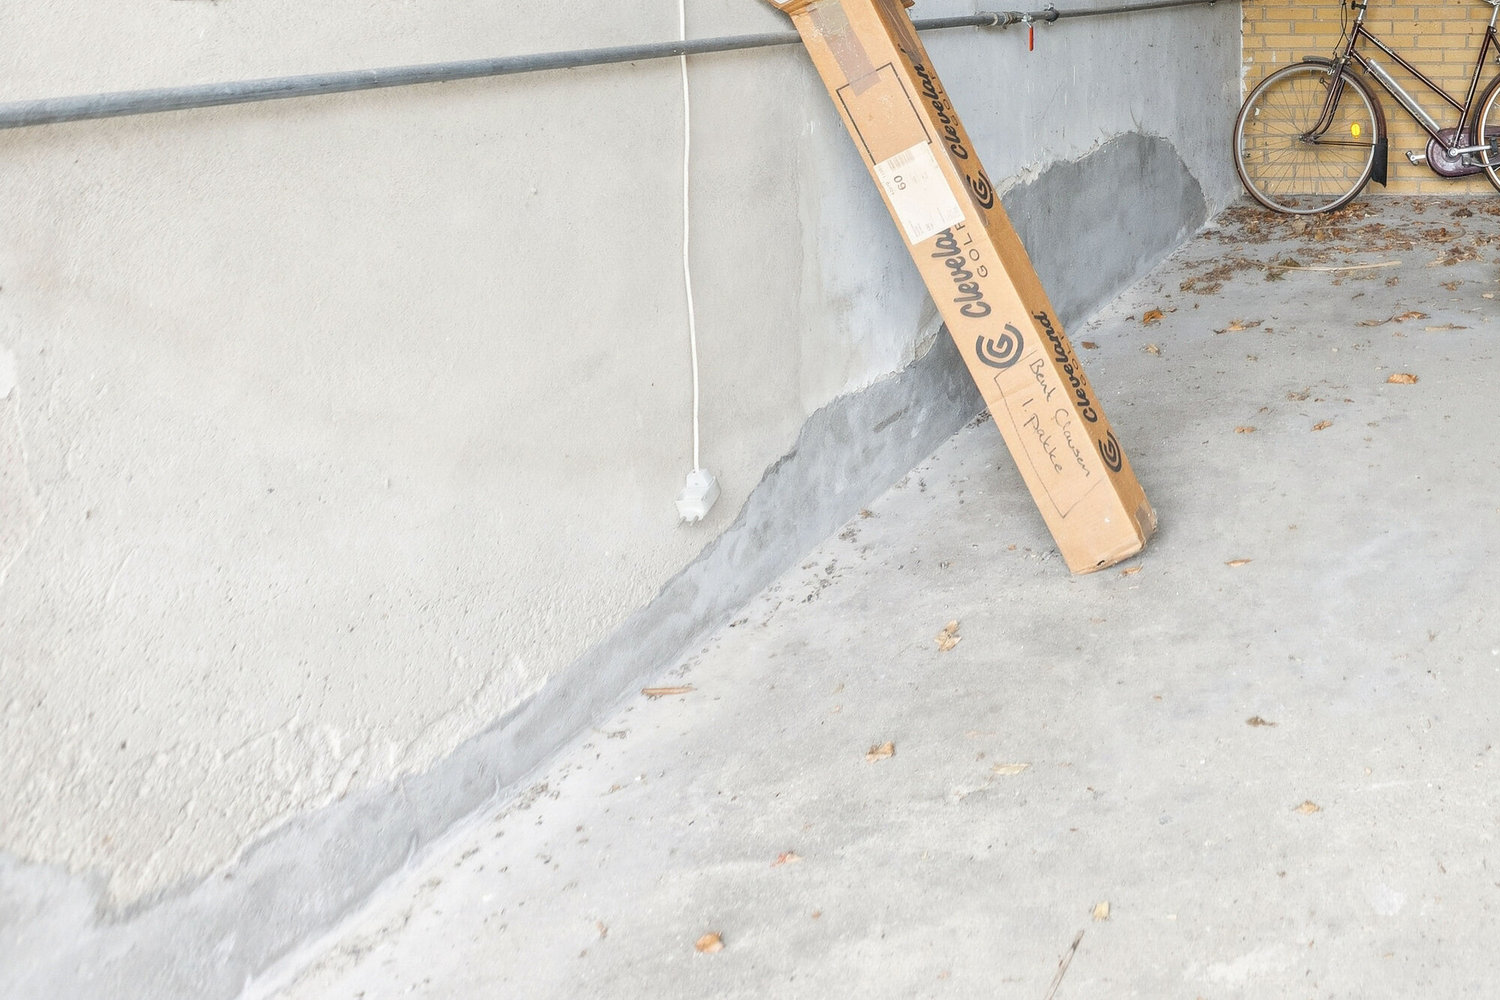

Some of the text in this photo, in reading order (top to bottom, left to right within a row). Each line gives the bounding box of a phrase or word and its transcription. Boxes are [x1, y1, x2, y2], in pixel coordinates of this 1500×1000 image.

[898, 45, 968, 160] Clevelan
[954, 222, 989, 278] GOLF
[1029, 358, 1091, 478] Bent Clausen
[1033, 311, 1098, 424] Cleveland
